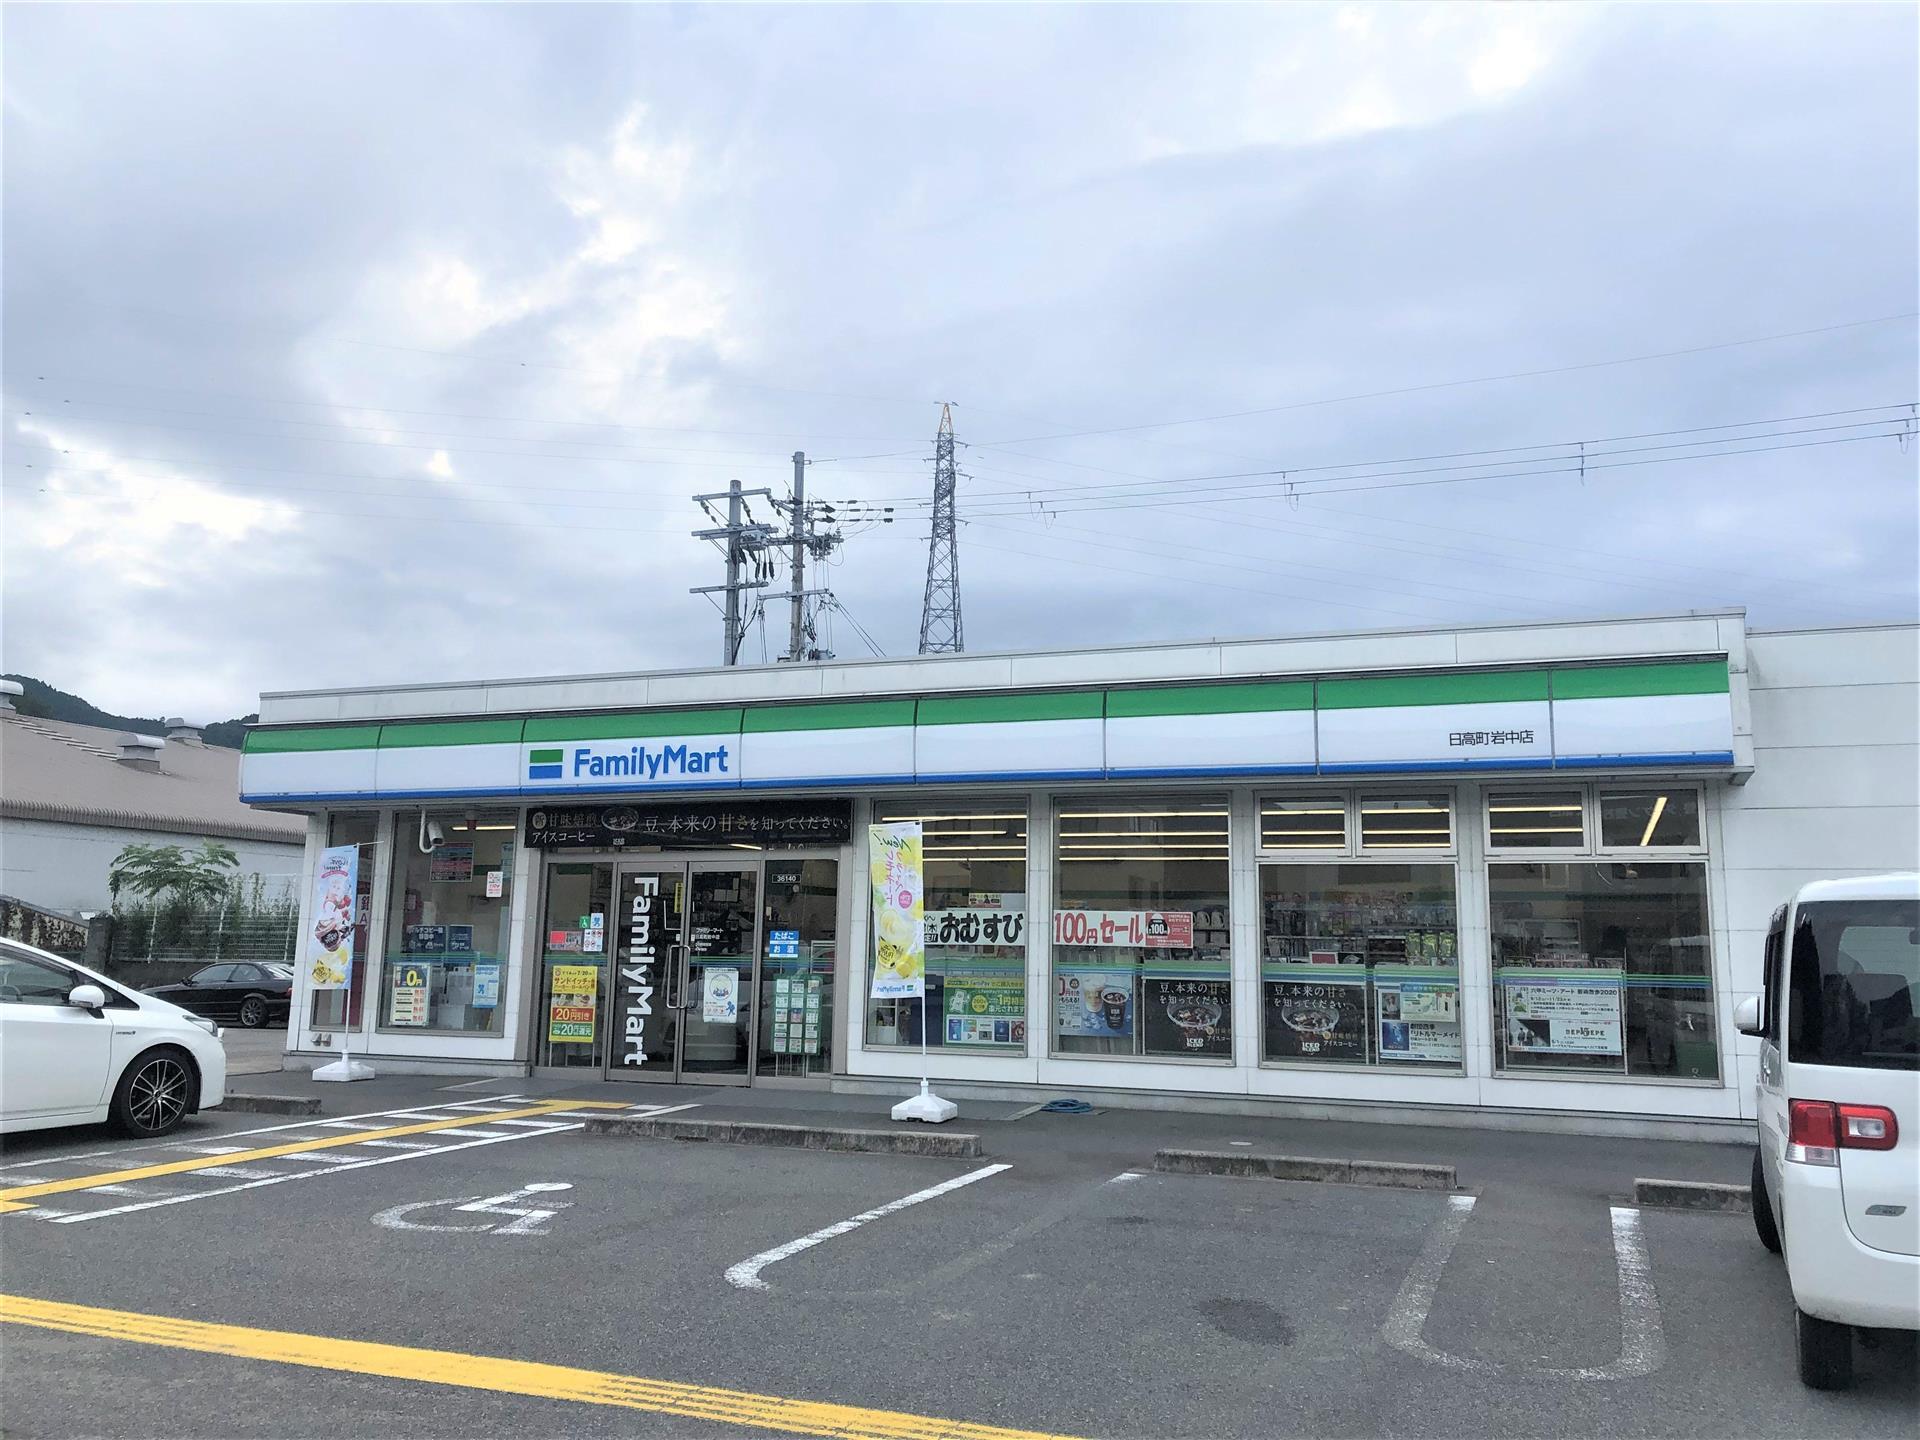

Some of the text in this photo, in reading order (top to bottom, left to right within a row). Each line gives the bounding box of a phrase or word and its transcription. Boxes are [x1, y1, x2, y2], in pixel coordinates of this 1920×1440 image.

[1449, 730, 1534, 746] 日高町岩中店
[574, 745, 728, 779] FamilyMart
[643, 813, 849, 833] 豆、本来の甘さを知ってください。
[532, 831, 596, 844] アイスコーヒー
[774, 932, 795, 940] たばこ
[940, 913, 1024, 944] おむすび
[1055, 911, 1144, 945] 100円セール
[622, 876, 659, 1066] FamilyMart
[1159, 983, 1229, 995] 豆、本来の甘さ
[1274, 984, 1346, 998] 豆、本来の甘さ
